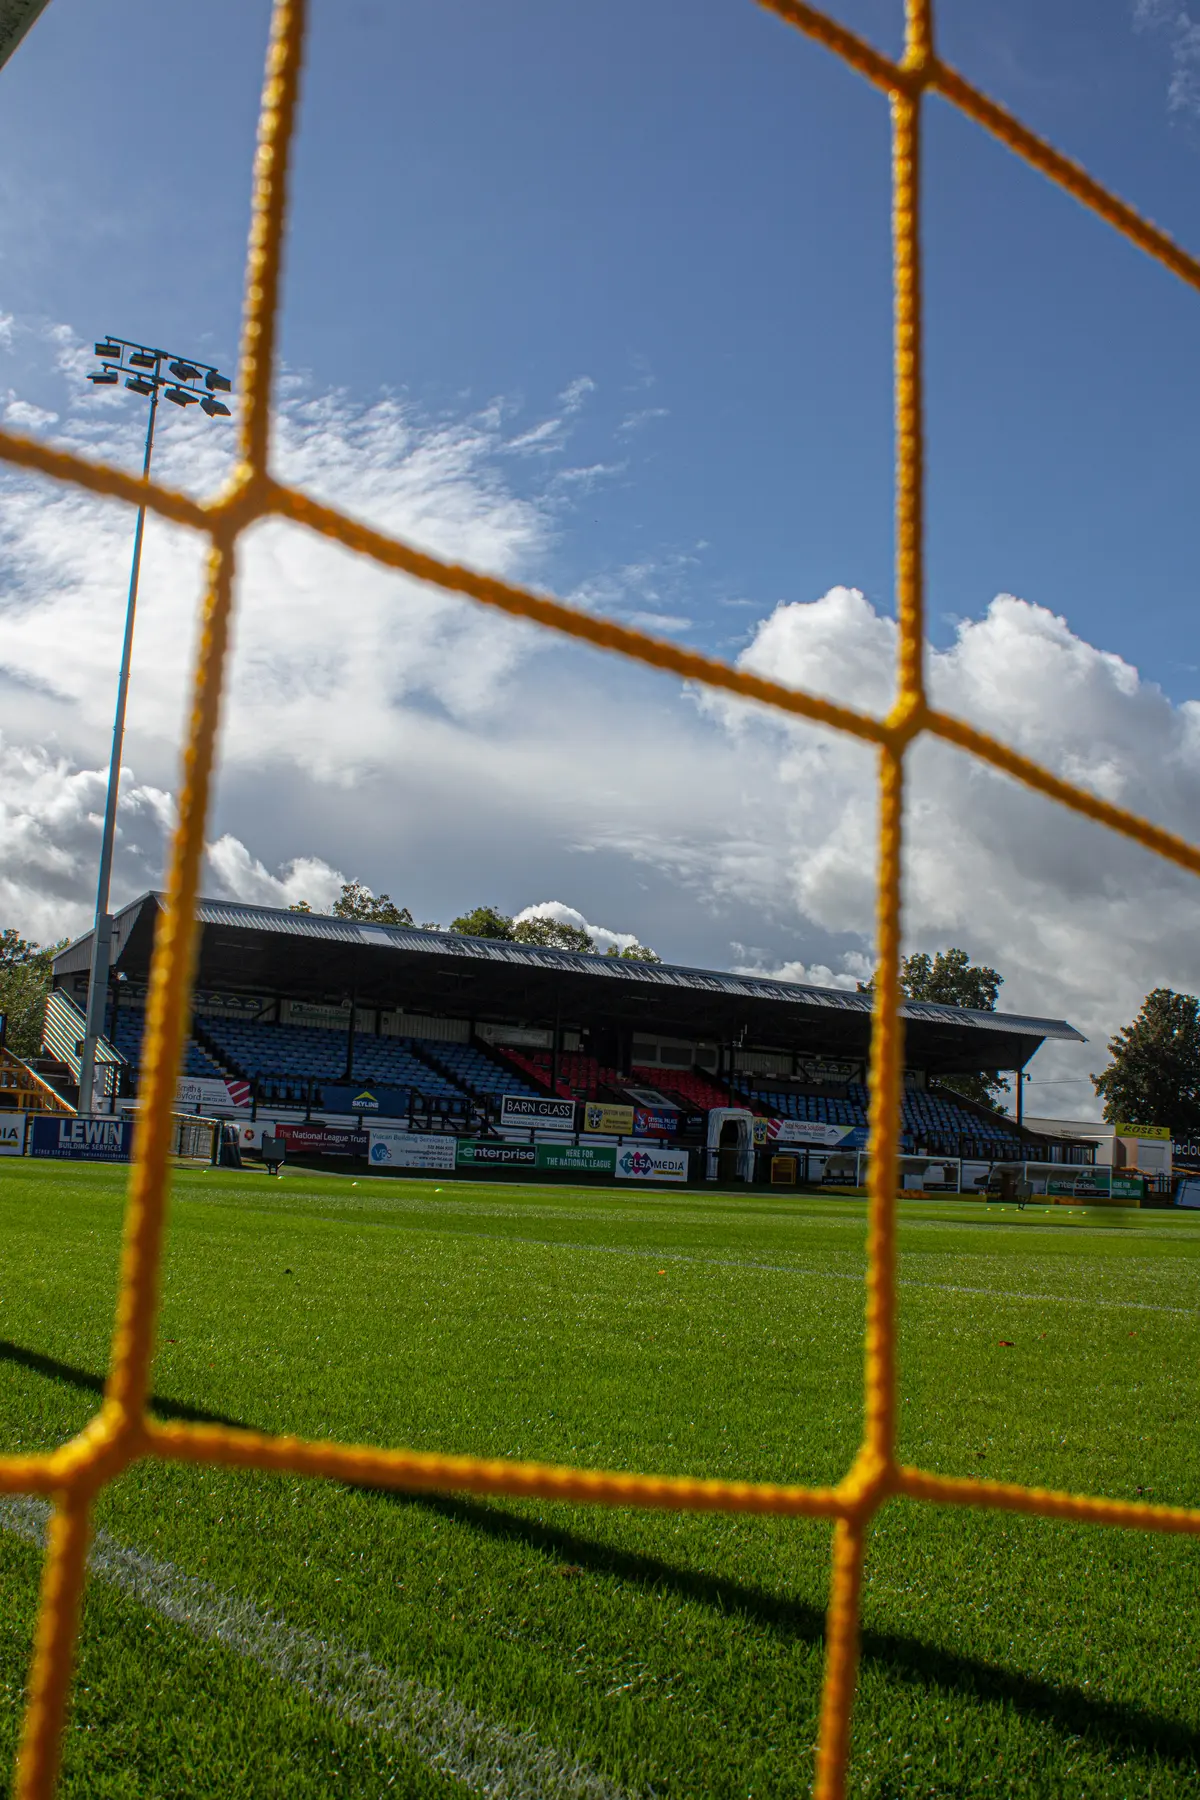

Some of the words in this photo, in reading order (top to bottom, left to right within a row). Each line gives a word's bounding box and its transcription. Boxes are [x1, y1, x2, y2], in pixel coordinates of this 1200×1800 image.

[176, 1092, 202, 1102] Byford
[352, 1101, 379, 1109] SKYLINE
[507, 1101, 535, 1113] BARN
[539, 1104, 571, 1116] GLASS
[59, 1120, 123, 1145] LEWIN
[1124, 1125, 1162, 1136] ROSES
[278, 1129, 291, 1138] The
[292, 1131, 322, 1140] National
[324, 1131, 348, 1142] League
[350, 1134, 367, 1144] Trust
[394, 1134, 418, 1143] Building
[58, 1142, 89, 1151] BUILDING
[92, 1144, 122, 1152] SERVICES
[464, 1144, 534, 1161] enterprise
[375, 1147, 393, 1159] VBS
[565, 1149, 581, 1157] HERE
[583, 1150, 594, 1158] FOR
[547, 1157, 558, 1166] THE
[559, 1158, 587, 1168] NATIONAL
[589, 1160, 612, 1169] LEAGUE
